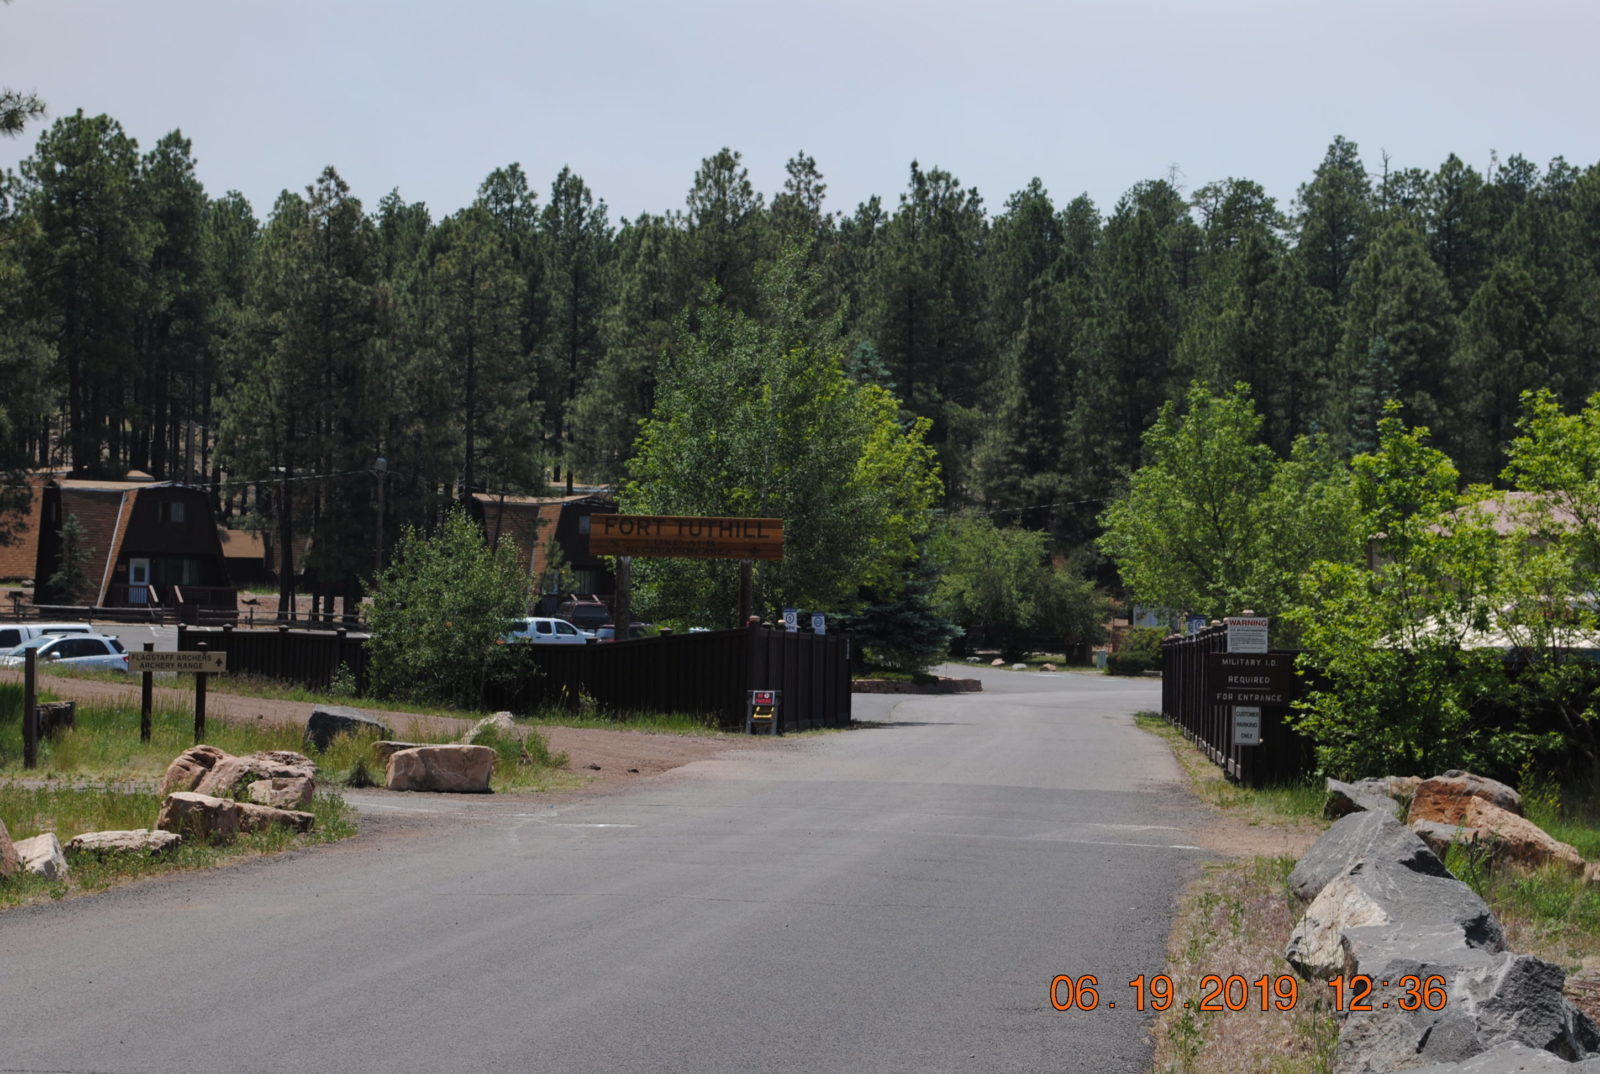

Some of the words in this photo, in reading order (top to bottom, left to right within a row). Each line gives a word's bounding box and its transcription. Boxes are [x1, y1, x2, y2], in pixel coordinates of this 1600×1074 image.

[603, 517, 664, 537] FORT
[676, 518, 770, 539] TUTHILL
[1229, 619, 1268, 627] WARNING
[131, 654, 174, 662] FLAGSTAFF
[176, 654, 212, 662] ARCHERS
[1221, 658, 1261, 667] MILITARY
[139, 662, 174, 670] ARCHERY
[177, 662, 204, 670] RANGE
[1227, 675, 1271, 684] REQUIRED
[1216, 692, 1234, 701] FOR
[1238, 693, 1282, 702] ENTRANCE
